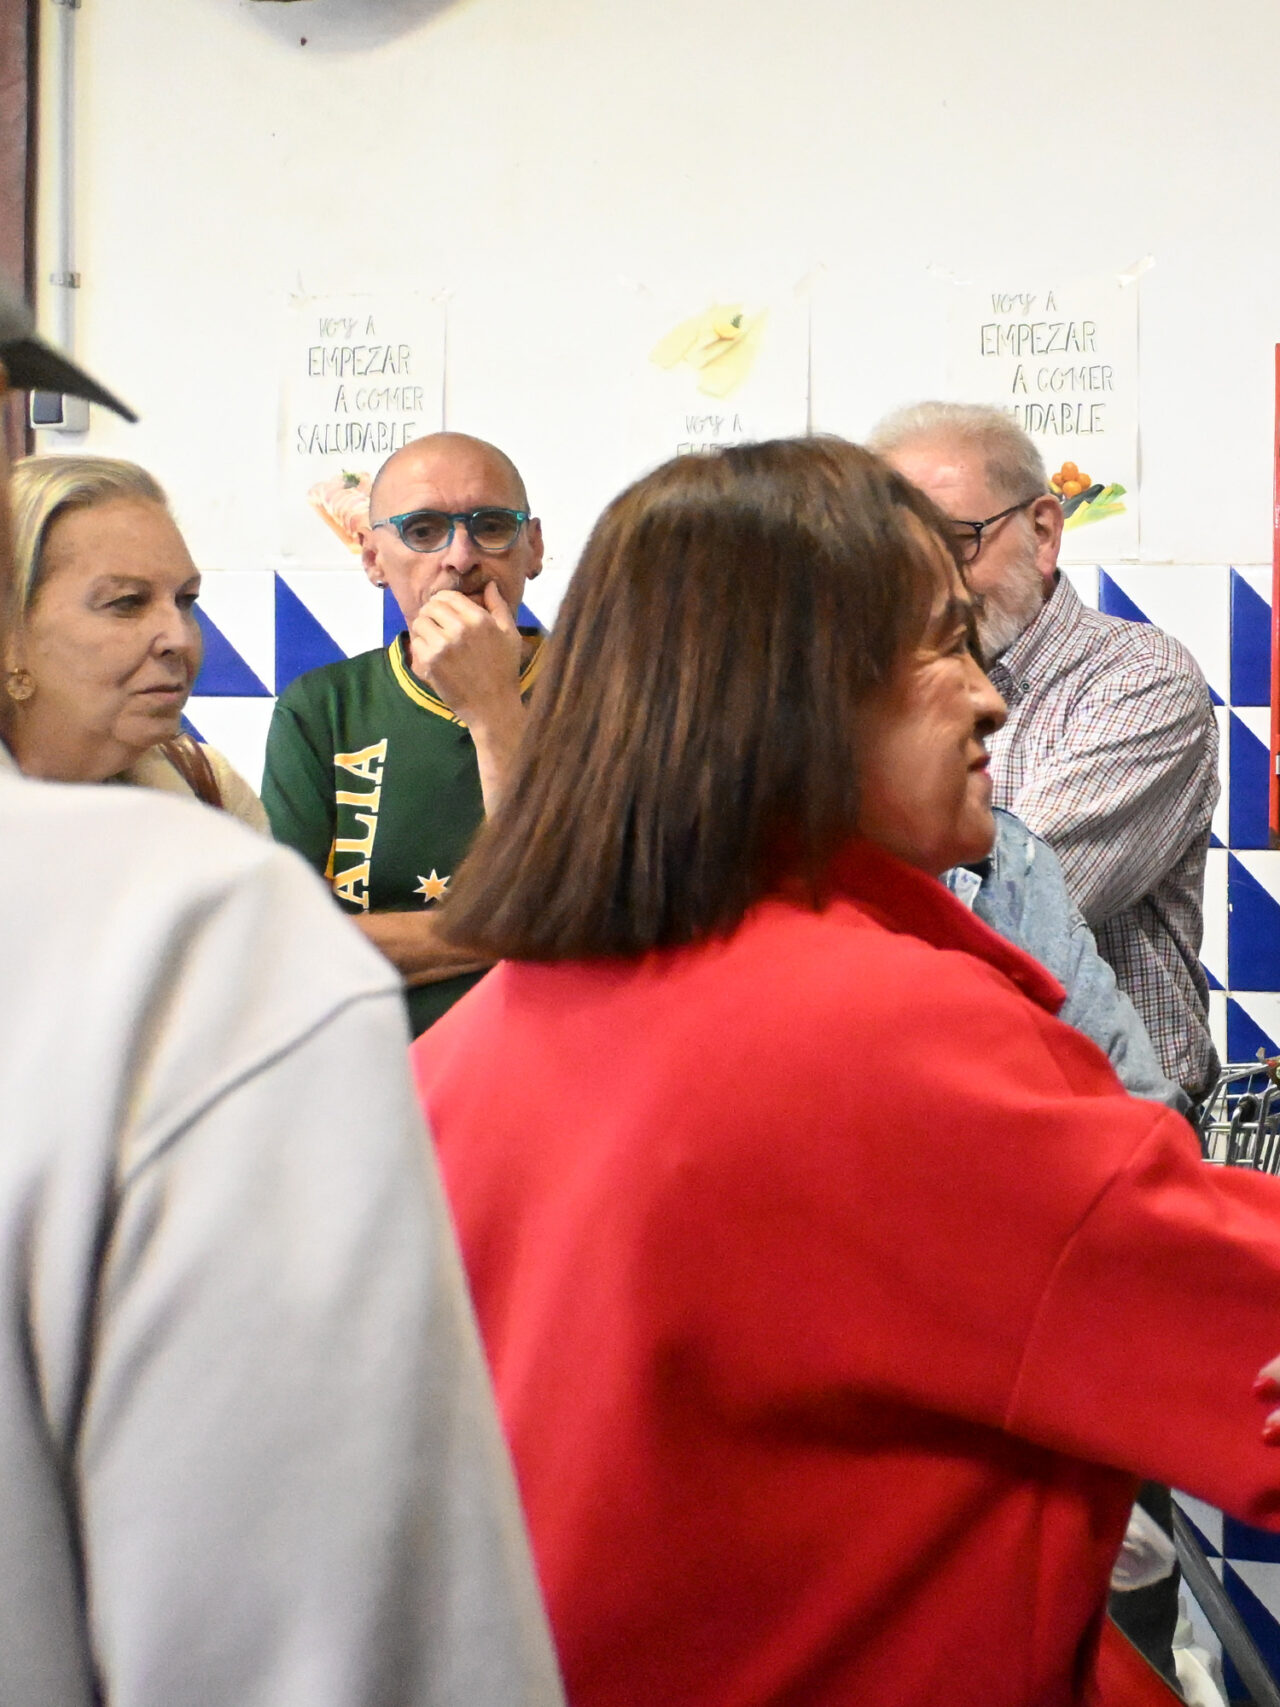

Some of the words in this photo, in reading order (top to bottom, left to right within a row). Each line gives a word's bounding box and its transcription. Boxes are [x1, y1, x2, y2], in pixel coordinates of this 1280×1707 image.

[1045, 290, 1057, 312] A
[366, 315, 376, 336] A
[980, 321, 1097, 357] EMPEZAR
[308, 344, 411, 377] EMPEZAR
[1012, 364, 1028, 394] A
[1036, 364, 1115, 393] COMER
[334, 384, 348, 414] A
[356, 386, 424, 412] COMER
[733, 412, 743, 433] A
[1004, 402, 1106, 436] UDABLE
[297, 421, 416, 456] SALUDABLE
[333, 737, 389, 914] ALIA
